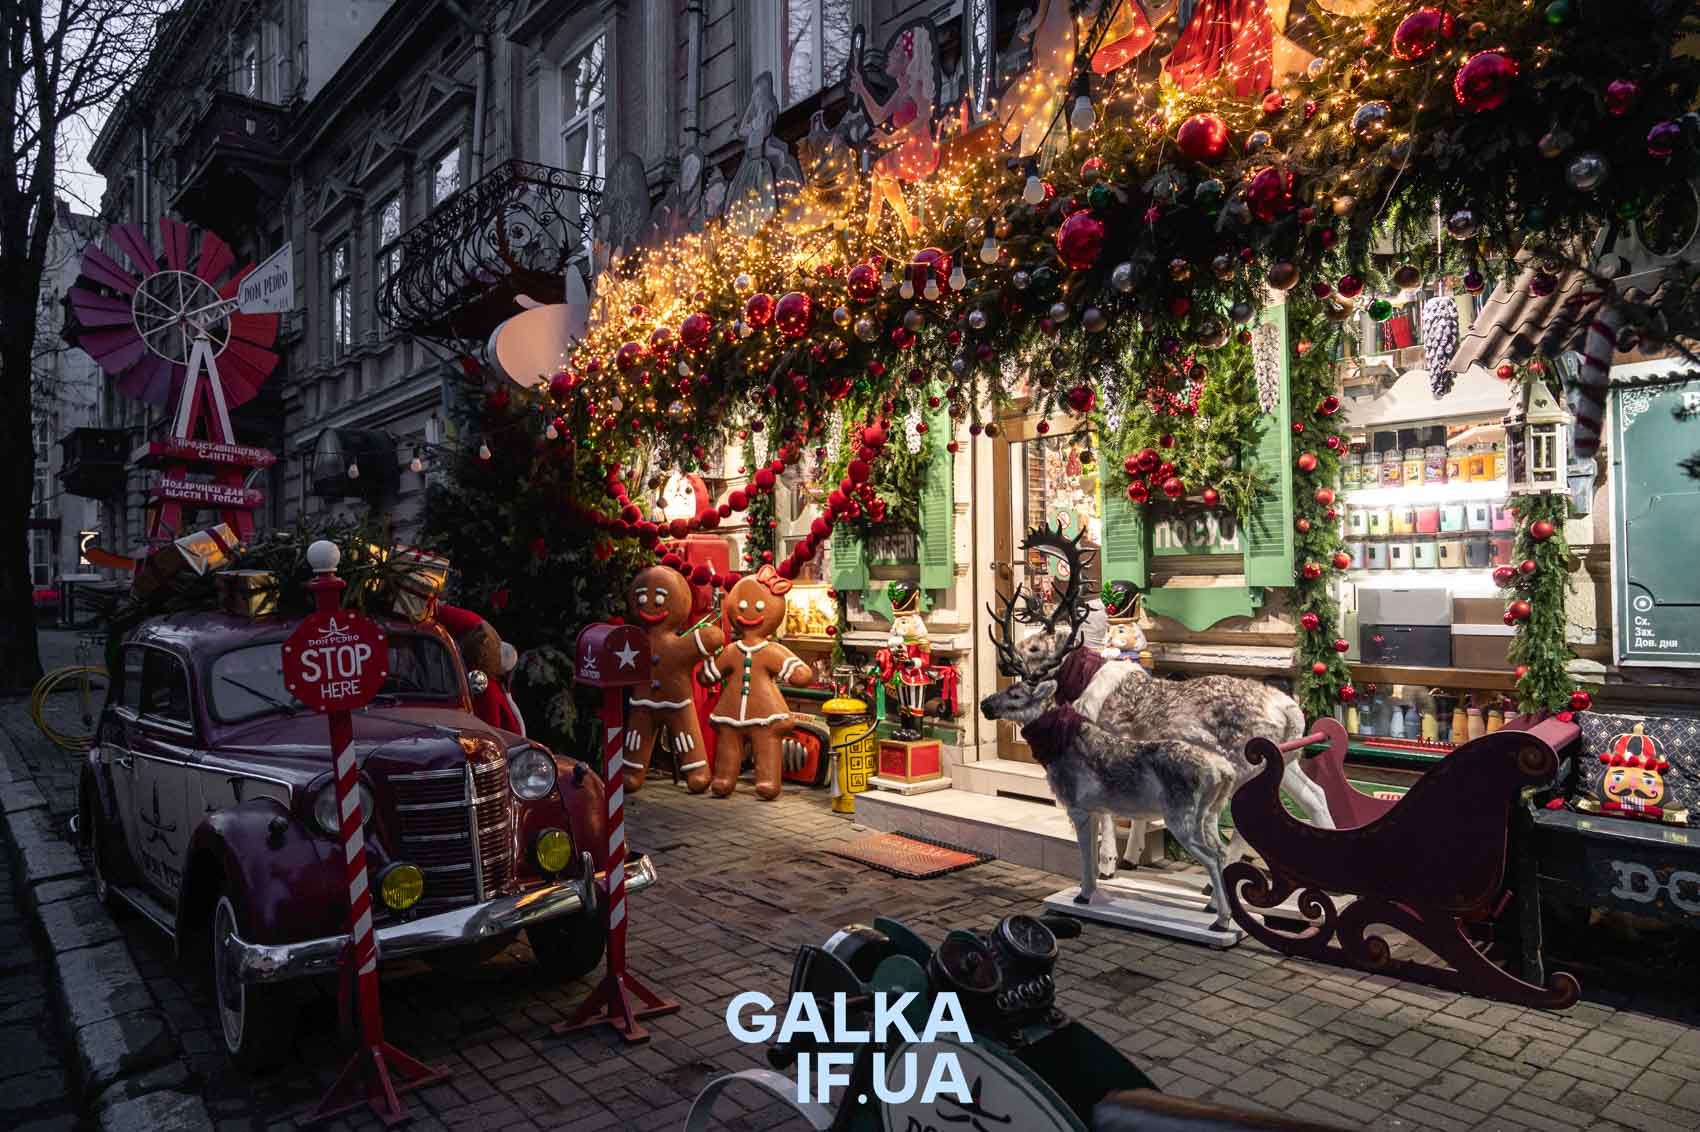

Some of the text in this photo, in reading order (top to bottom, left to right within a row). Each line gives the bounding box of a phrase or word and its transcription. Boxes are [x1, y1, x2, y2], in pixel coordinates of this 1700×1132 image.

[1634, 615, 1650, 626] Сх.
[1634, 627, 1656, 637] Зах.
[308, 634, 360, 647] DON PEDRO
[301, 643, 372, 682] STOP
[320, 679, 361, 699] HERE
